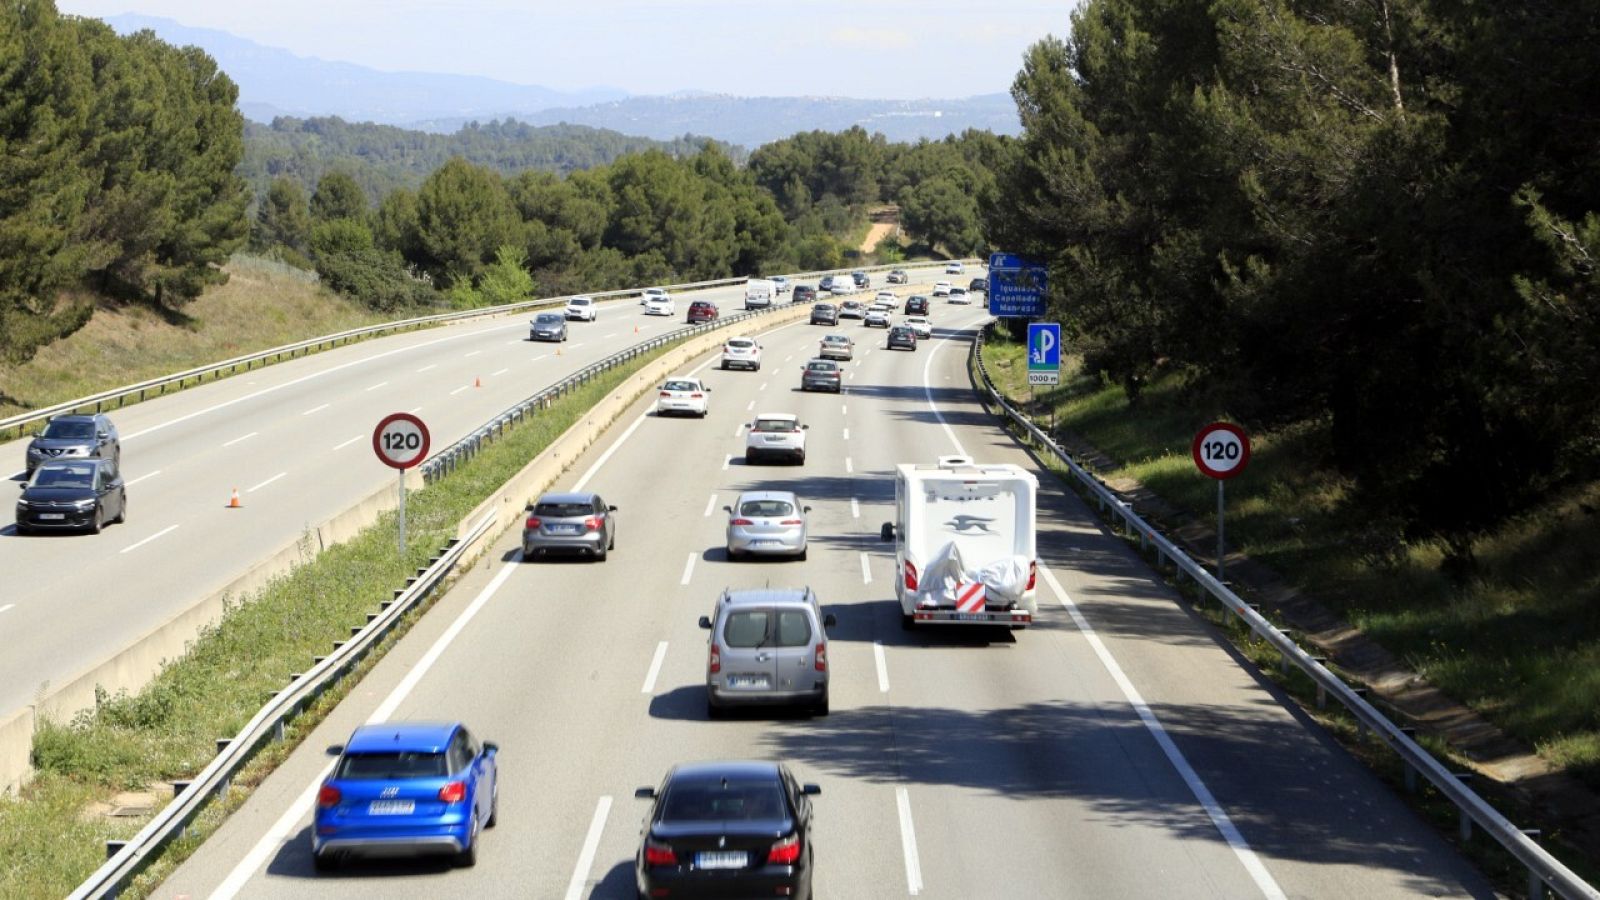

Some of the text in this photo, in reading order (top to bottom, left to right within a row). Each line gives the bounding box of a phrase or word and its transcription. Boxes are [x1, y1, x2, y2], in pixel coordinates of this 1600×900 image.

[1029, 374, 1049, 382] 1000
[383, 432, 420, 450] 120
[1204, 441, 1240, 460] 120
